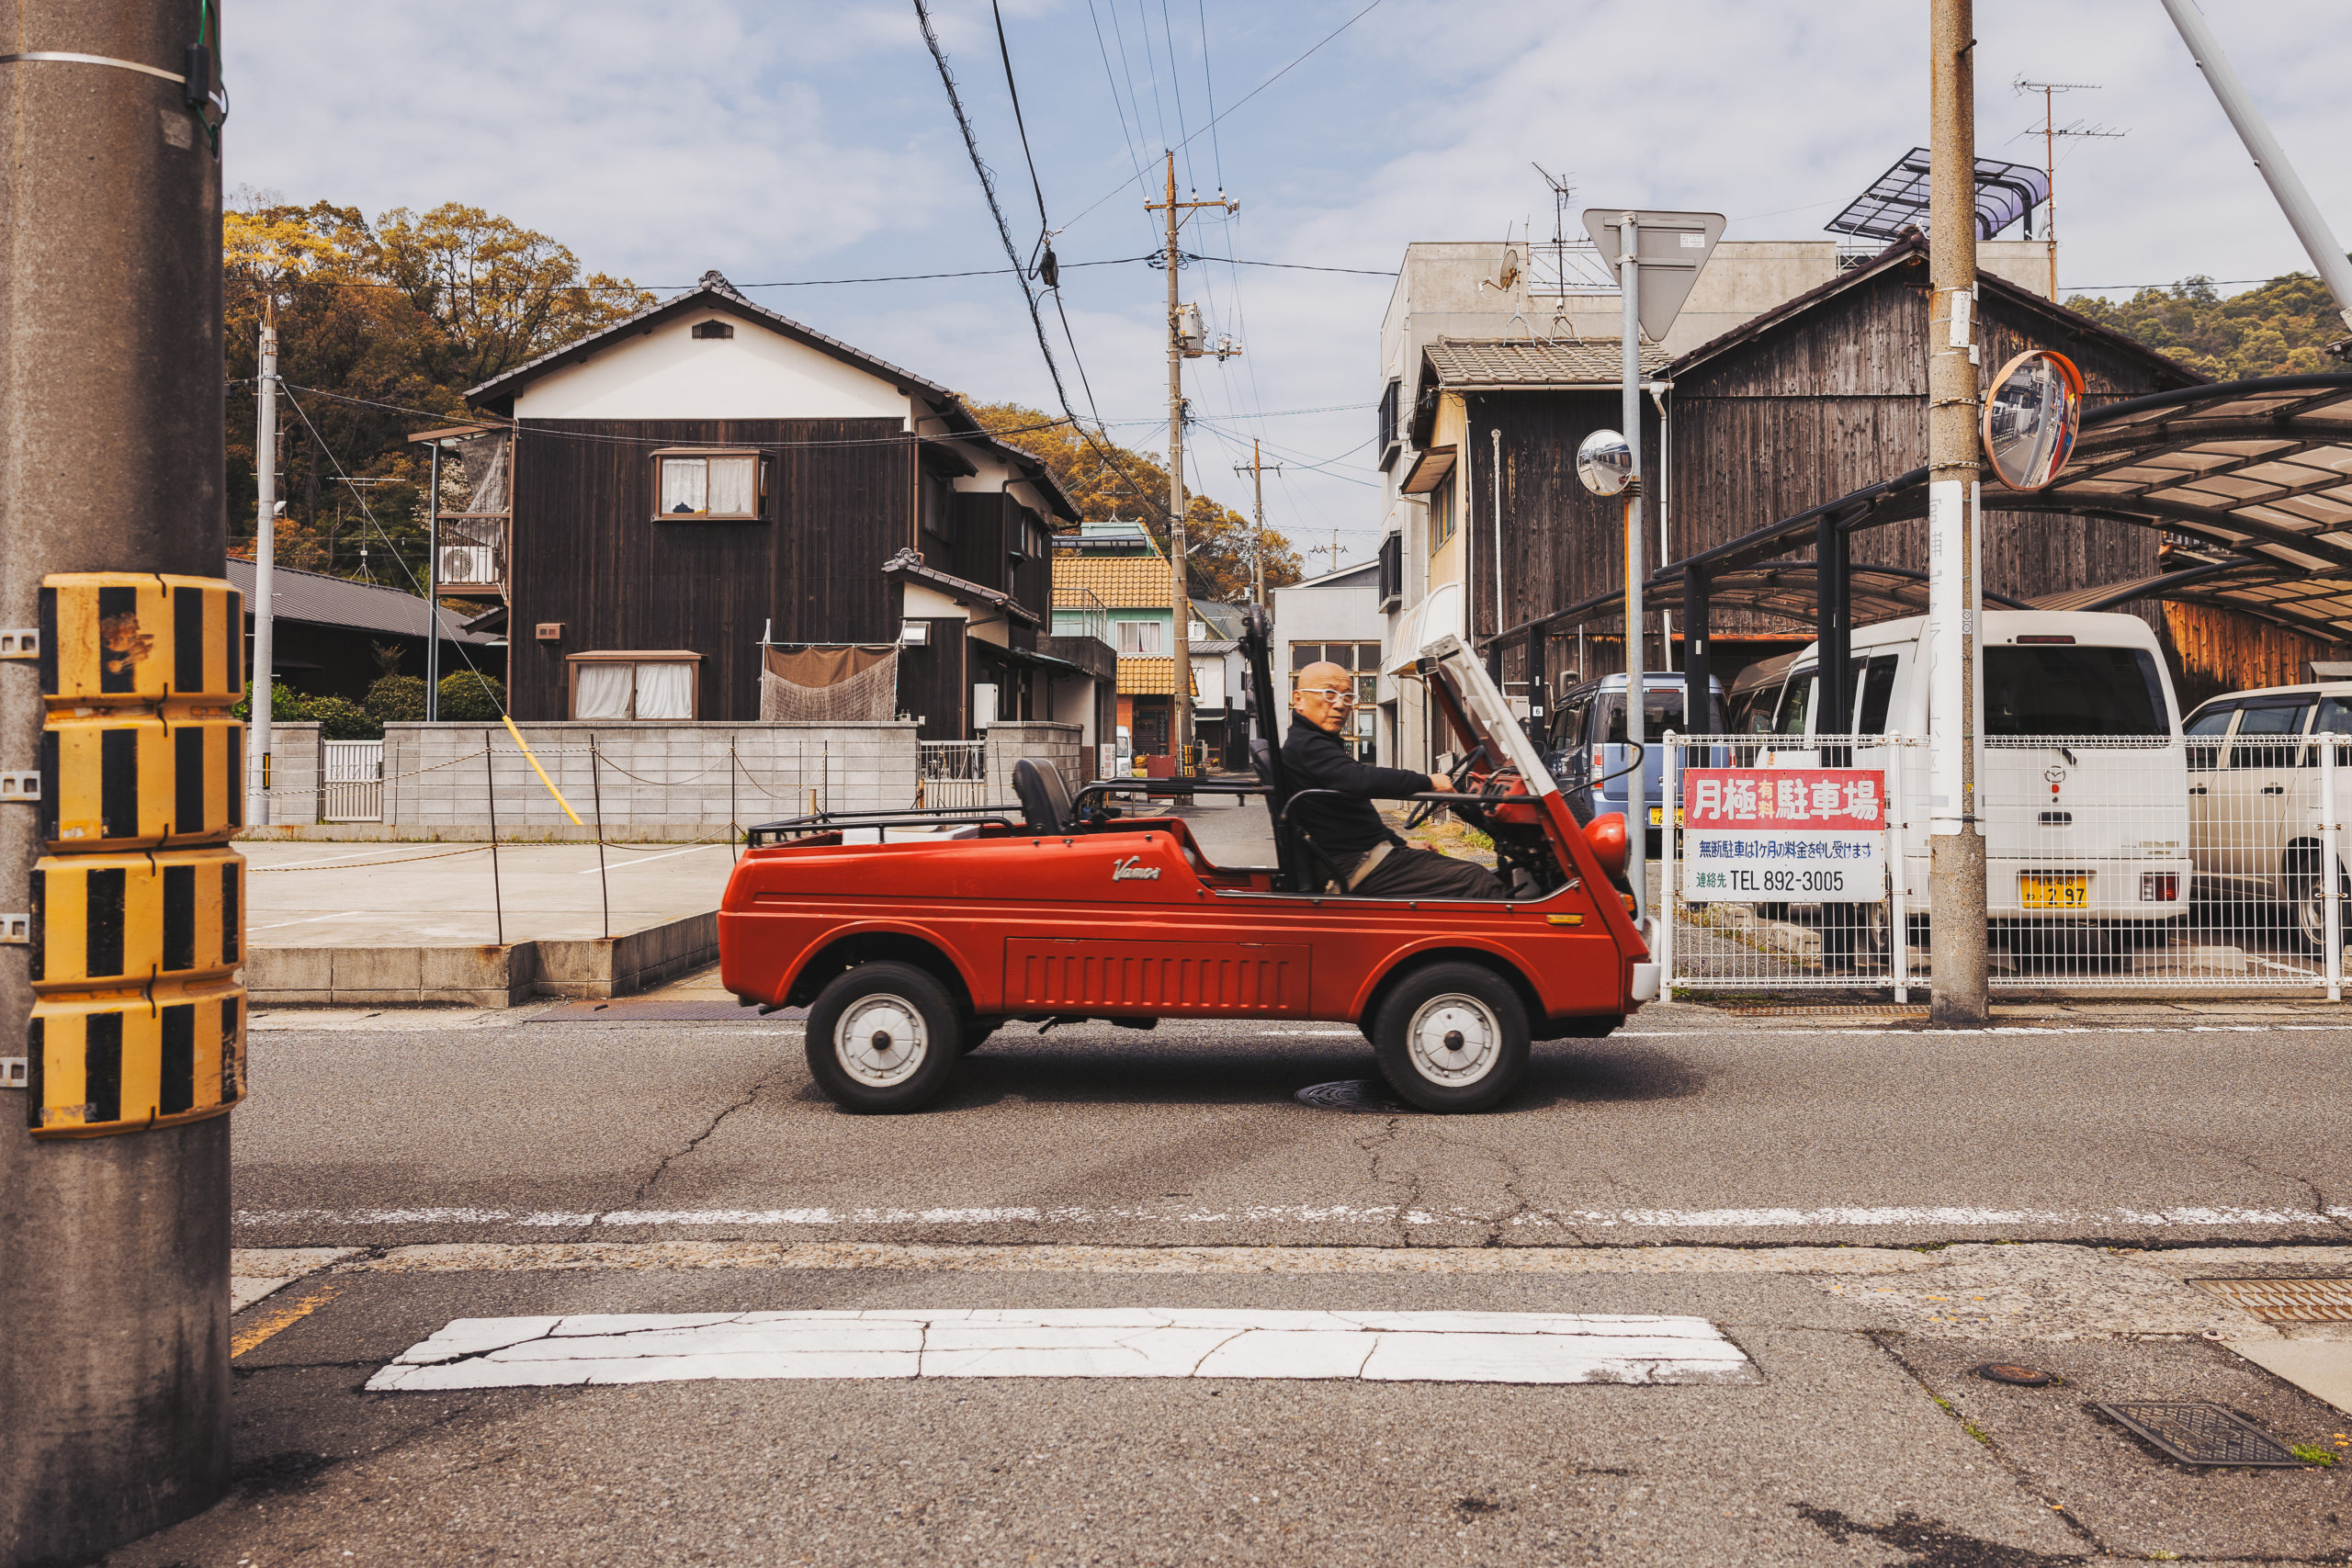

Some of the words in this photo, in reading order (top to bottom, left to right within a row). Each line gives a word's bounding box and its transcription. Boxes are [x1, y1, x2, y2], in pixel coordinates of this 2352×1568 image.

[1692, 778, 1757, 820] 月極
[1758, 780, 1775, 819] 有料
[1775, 778, 1879, 821] 駐車場
[1695, 872, 1727, 888] 連絡先
[1730, 870, 1760, 891] TEL
[1764, 871, 1843, 891] 892-3005
